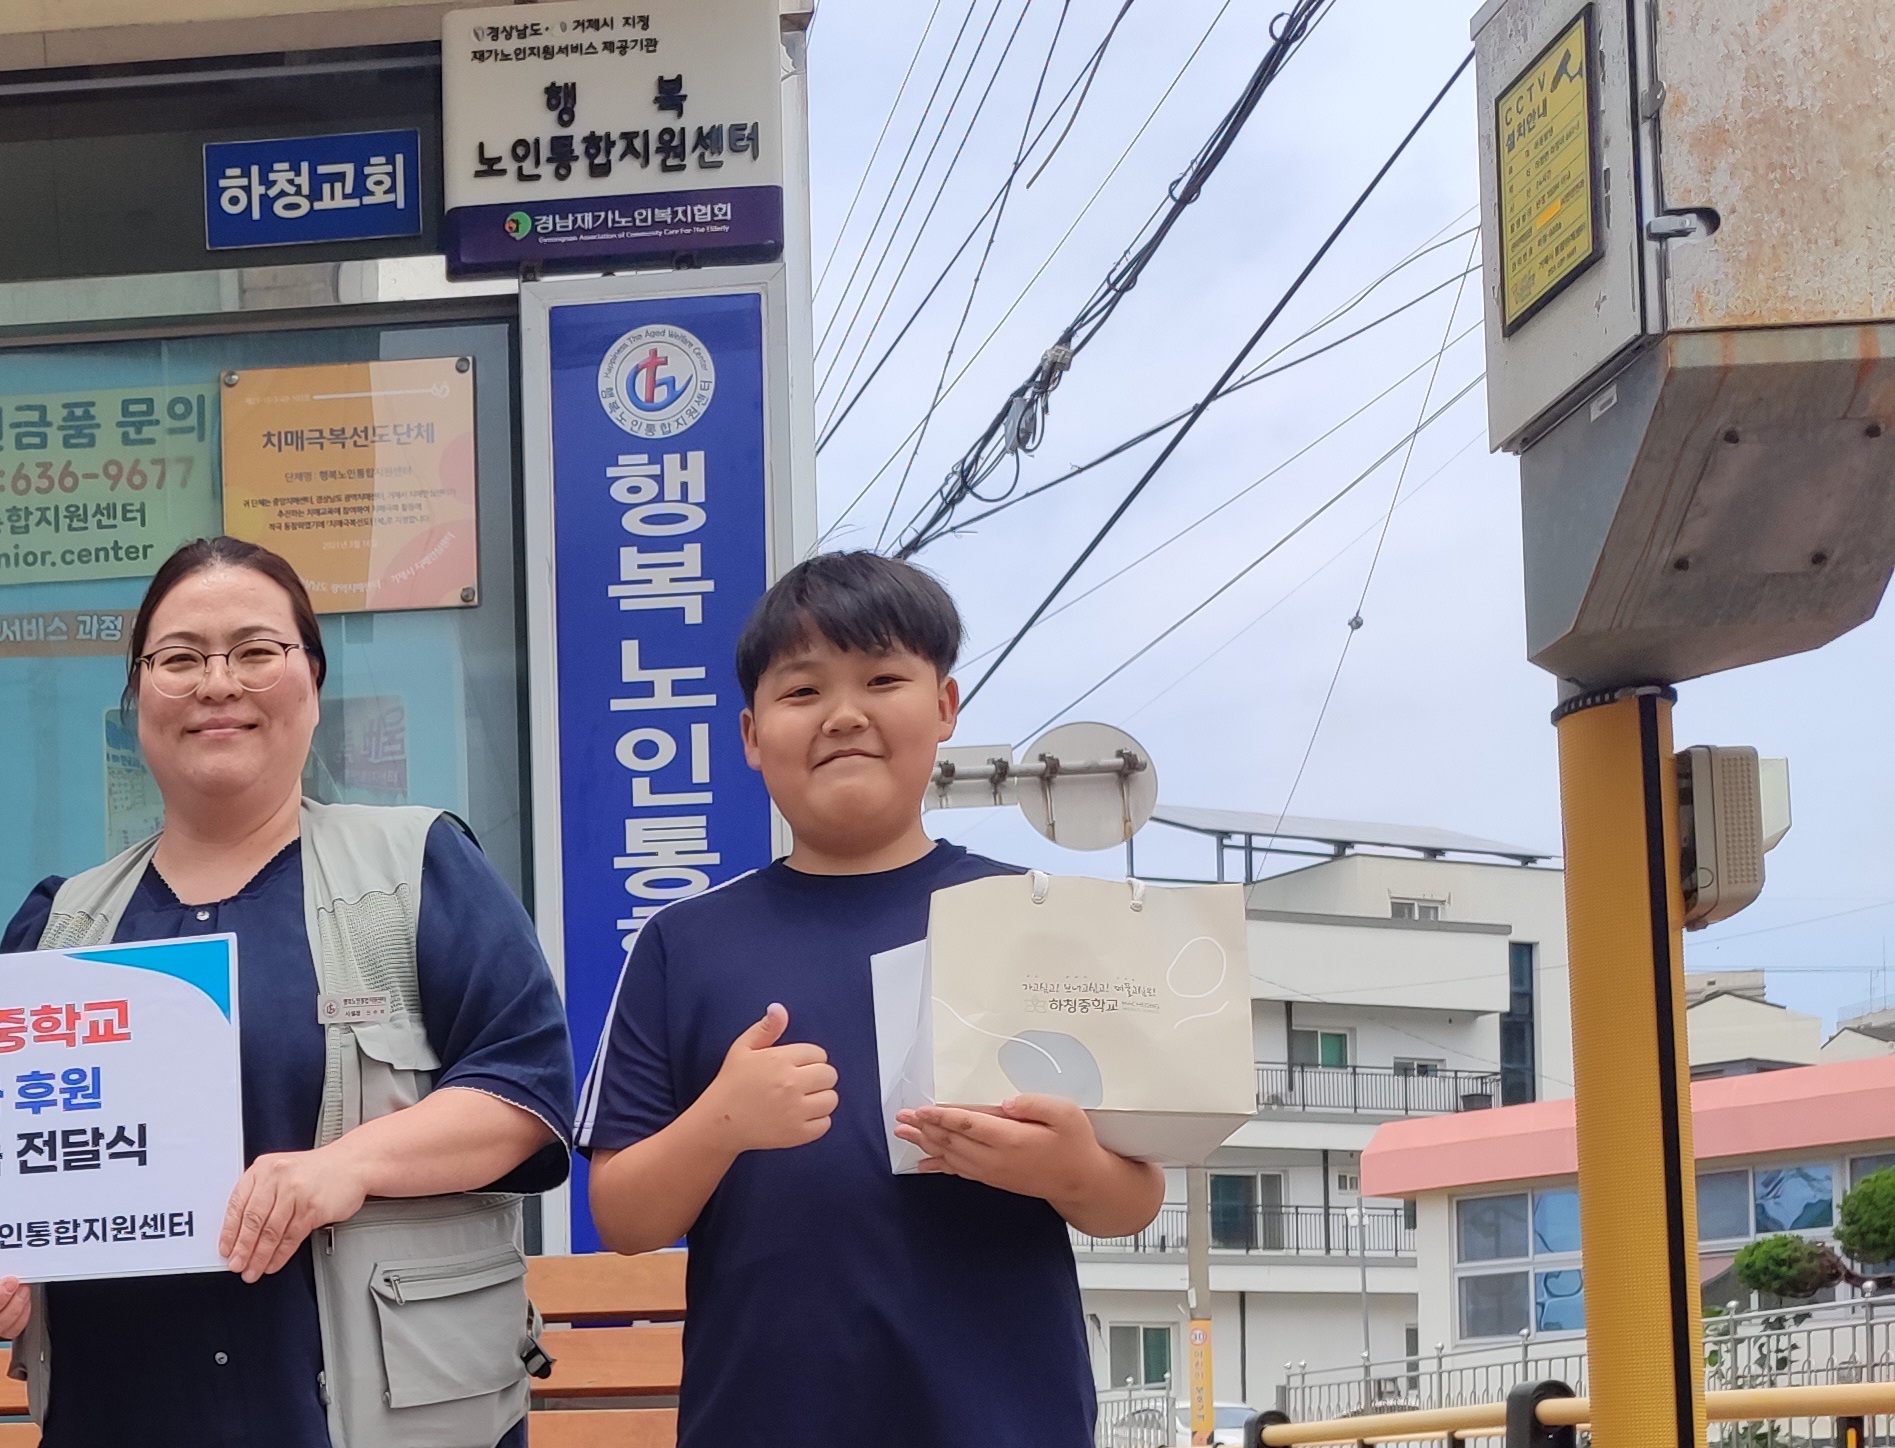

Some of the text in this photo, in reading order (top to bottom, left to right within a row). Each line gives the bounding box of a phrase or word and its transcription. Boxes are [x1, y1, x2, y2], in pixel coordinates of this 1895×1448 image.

[573, 16, 614, 33] 거제시
[622, 14, 650, 31] 지정
[471, 38, 659, 62] 재가노인지원서비스 제공기관
[474, 121, 759, 182] 노인통합지원센터
[218, 153, 405, 220] 하청교회
[534, 202, 731, 233] 경남재가노인복지협회
[645, 329, 666, 338] Aged
[668, 330, 694, 348] Welfare
[693, 347, 708, 371] Center
[116, 394, 206, 446] 문의
[261, 422, 435, 453] 치매극복선도단체
[76, 615, 123, 641] 과정
[1049, 997, 1119, 1013] 하청중학교
[14, 1066, 102, 1115] 후원
[16, 1123, 148, 1175] 전달식
